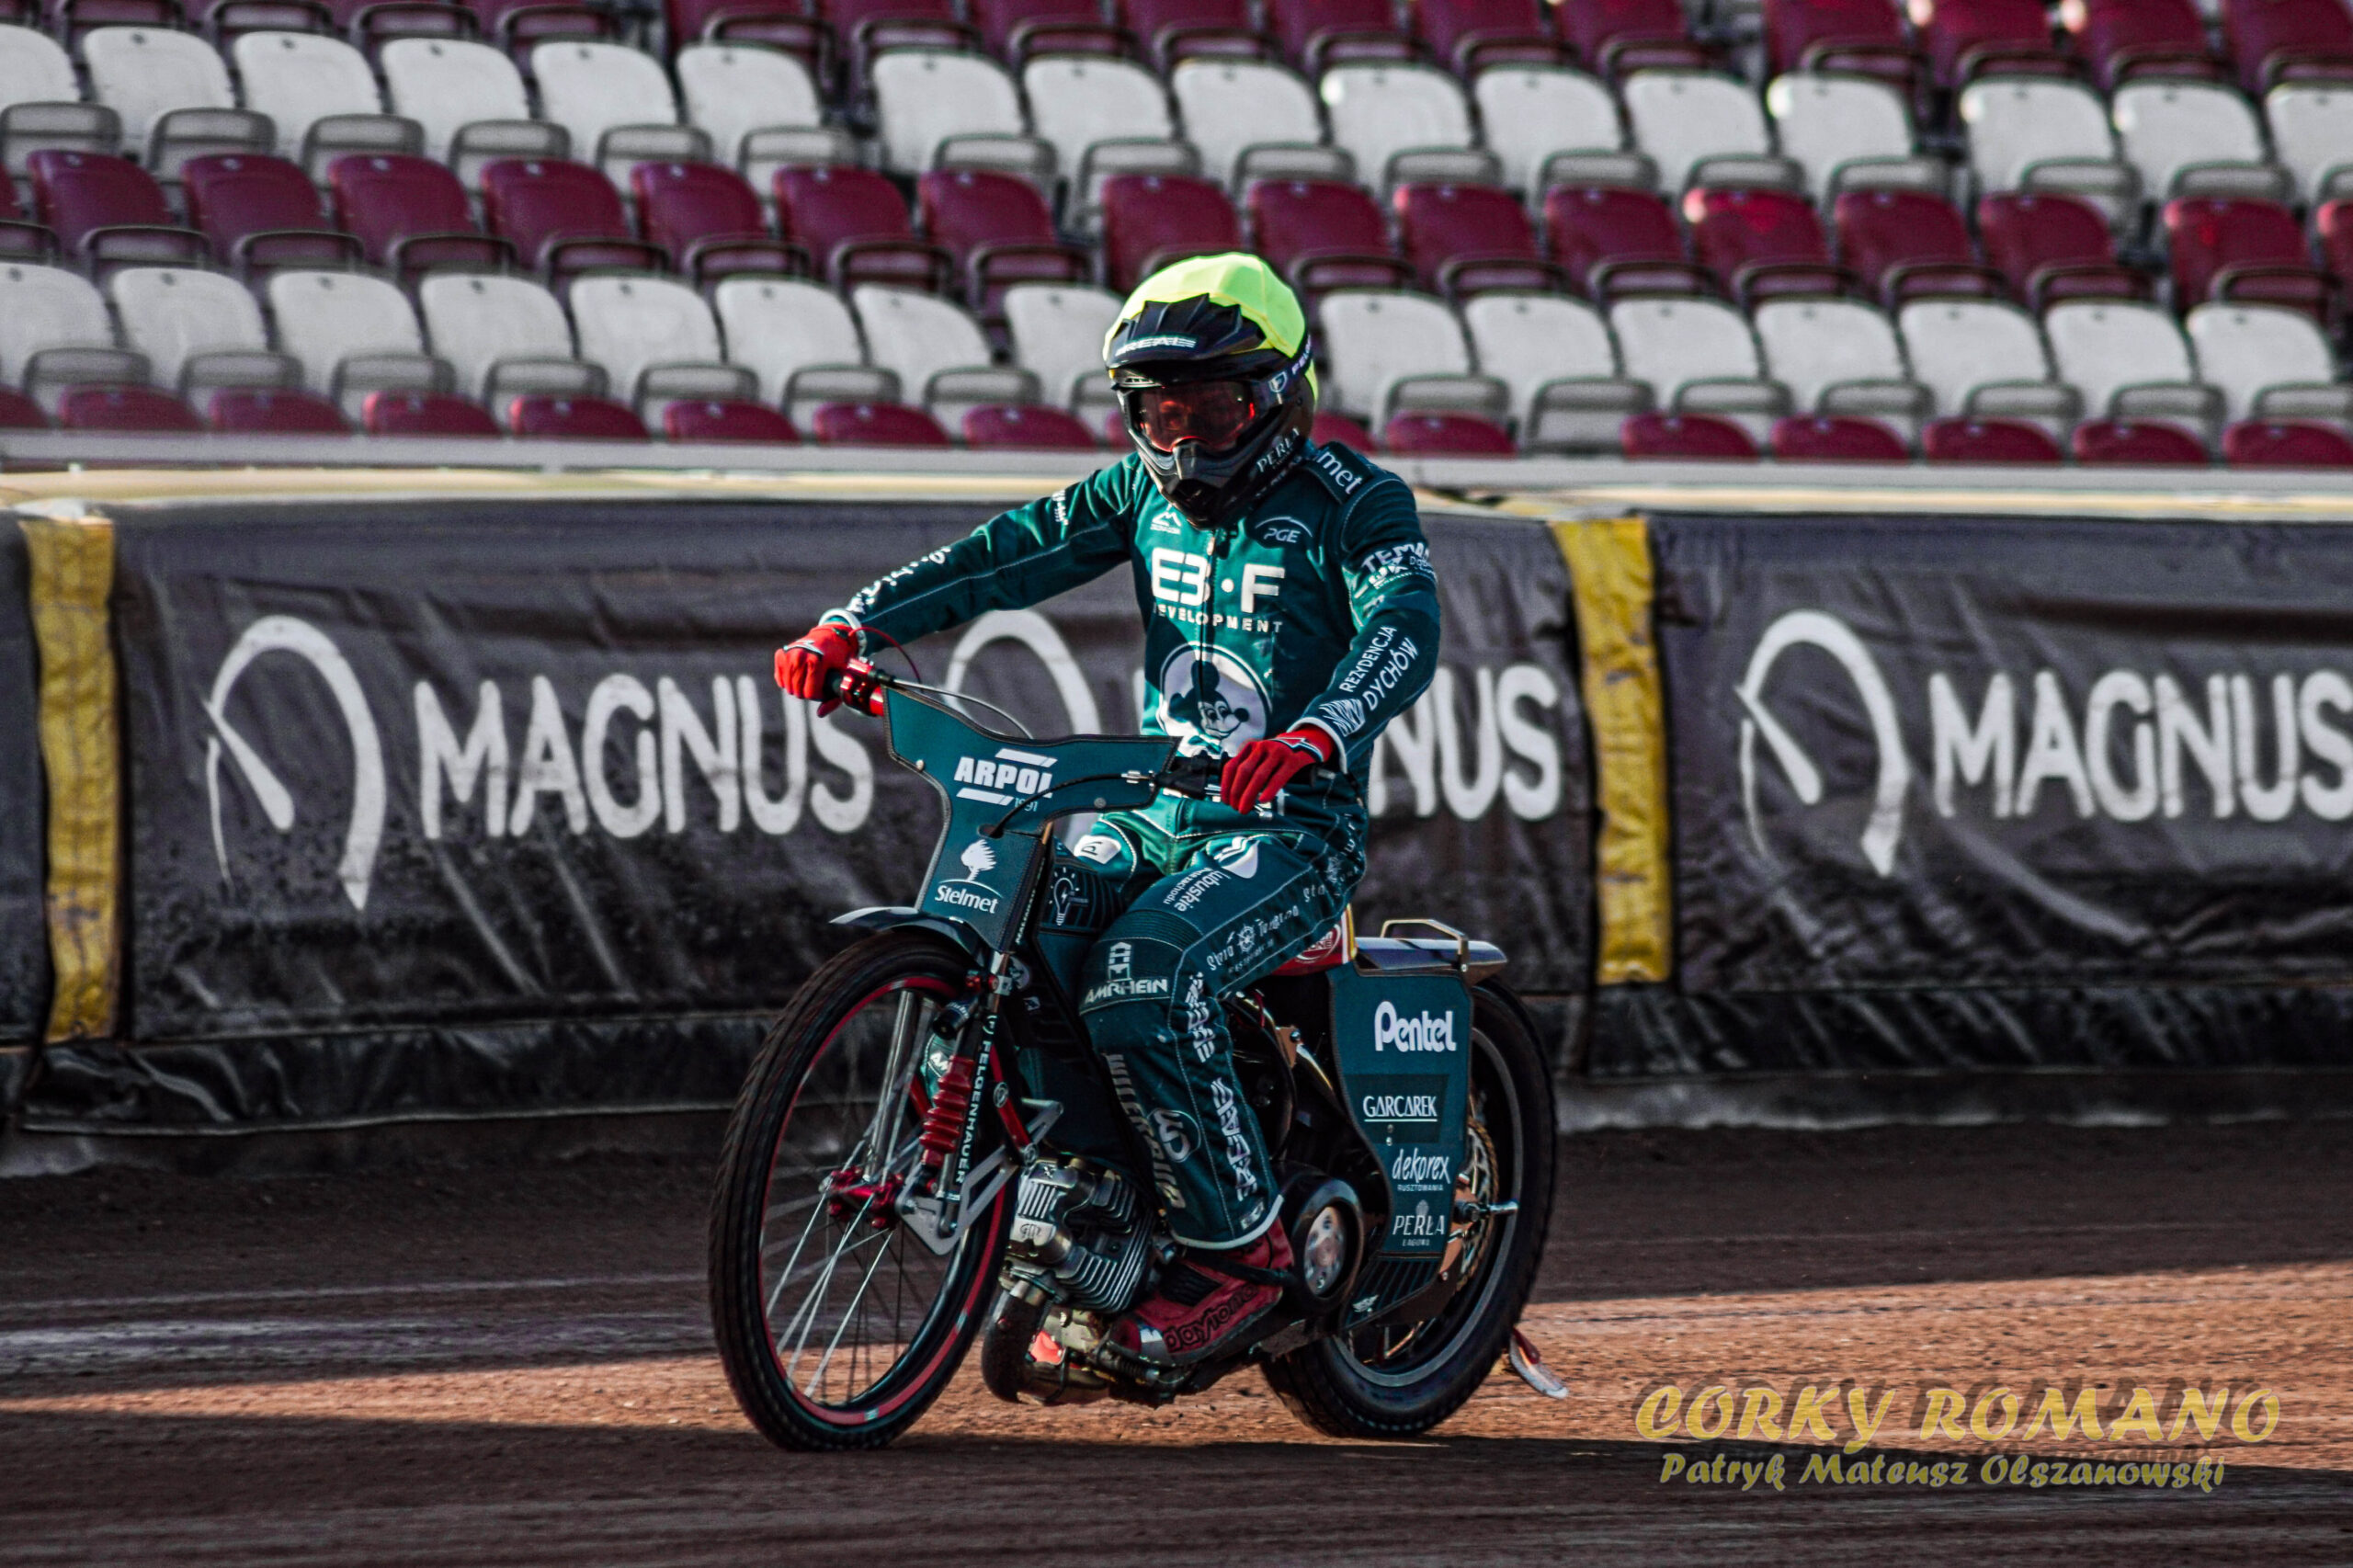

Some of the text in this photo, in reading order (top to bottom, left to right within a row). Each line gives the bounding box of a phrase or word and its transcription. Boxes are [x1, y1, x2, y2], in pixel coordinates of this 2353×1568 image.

[1317, 451, 1363, 494] met
[1264, 528, 1301, 543] PGE
[1338, 625, 1398, 692] REZYDENCJA
[1362, 637, 1419, 711] DYCHÓW
[414, 672, 875, 839] MAGNUS
[1369, 664, 1561, 822] NUS
[1929, 668, 2353, 823] MAGNUS
[953, 756, 1053, 799] ARPOL
[934, 884, 999, 915] Stelmet
[1085, 978, 1169, 1005] AMRHEIN
[1374, 1000, 1457, 1053] Pentel
[955, 1040, 993, 1185] FELGENHAUER
[1363, 1095, 1437, 1118] GARCAREK
[1392, 1147, 1450, 1185] dekorex
[1392, 1214, 1445, 1236] PERŁA
